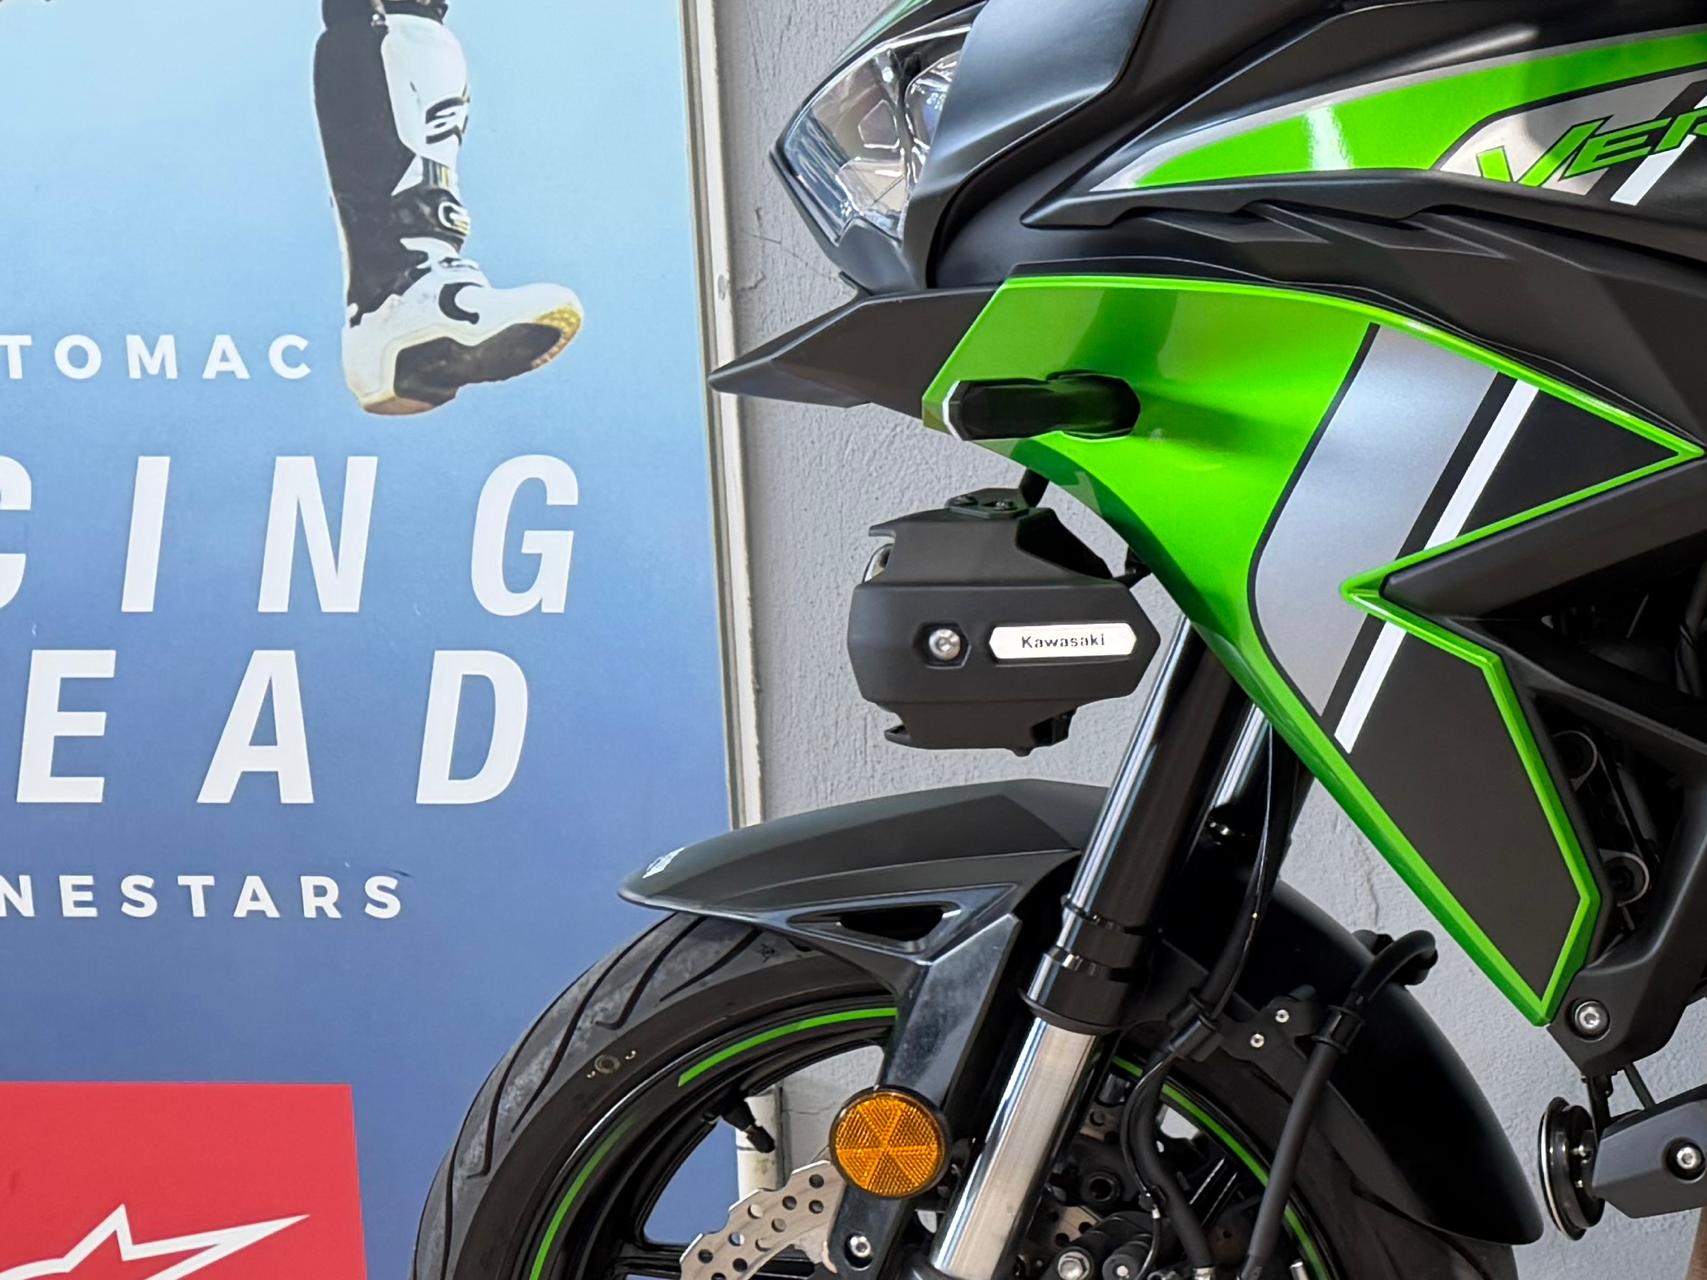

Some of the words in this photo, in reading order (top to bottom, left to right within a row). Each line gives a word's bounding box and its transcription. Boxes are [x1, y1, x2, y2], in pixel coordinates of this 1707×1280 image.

[0, 333, 312, 381] TOMAC
[1020, 632, 1105, 649] Kawasaki
[16, 649, 529, 804] EAD
